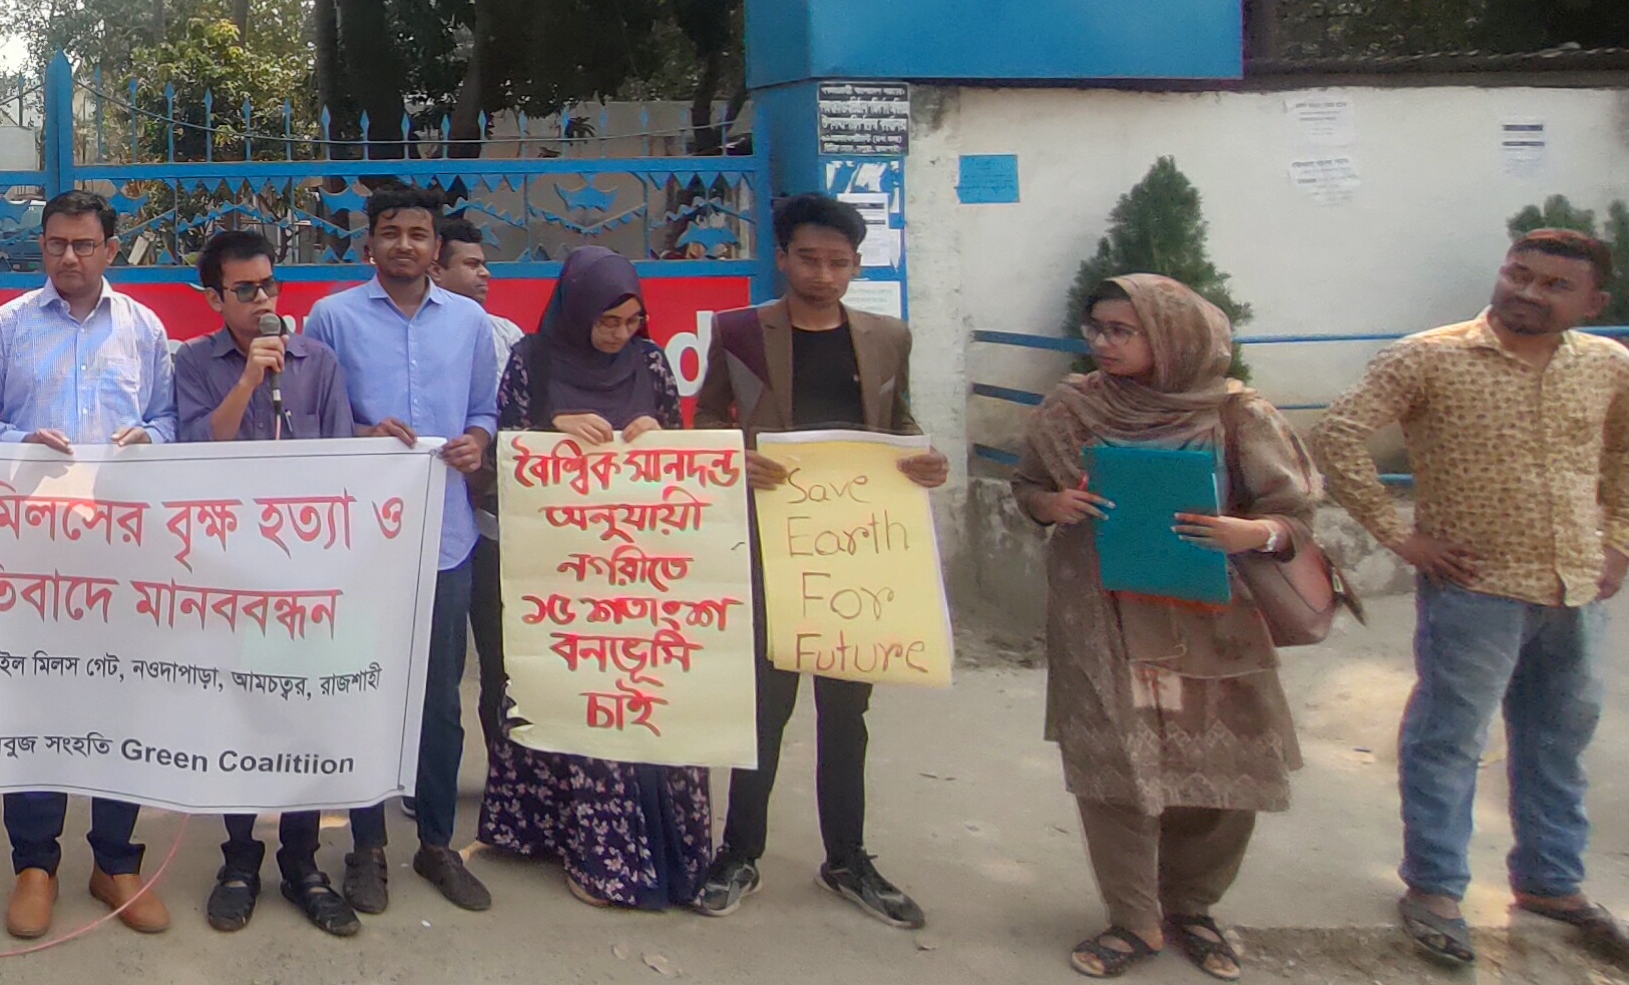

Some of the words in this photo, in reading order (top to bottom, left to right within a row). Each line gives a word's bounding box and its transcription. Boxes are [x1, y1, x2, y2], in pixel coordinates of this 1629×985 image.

[512, 436, 619, 494] বৈশ্বিক
[786, 467, 871, 504] Save
[161, 498, 242, 573] বৃক্ষ
[253, 488, 357, 559] হত্যা
[372, 497, 404, 540] ও
[539, 486, 712, 542] অনুযায়ী
[787, 509, 909, 557] Earth
[557, 546, 694, 591] নগরীতে
[131, 578, 344, 641] মানববন্ধন
[522, 594, 574, 625] ১৫
[580, 595, 742, 632] শতাংশ
[801, 571, 895, 620] For
[32, 650, 77, 677] মিলস
[86, 652, 124, 682] গেট,
[132, 660, 224, 691] নওদাপাড়া,
[232, 670, 312, 700] আমচত্বর,
[320, 662, 382, 697] রাজশাহী
[550, 630, 704, 686] বনভূমি
[796, 630, 929, 673] Future
[580, 679, 668, 737] চাই
[44, 731, 111, 756] সংহতি
[120, 739, 208, 772] Green
[218, 749, 354, 775] Coalitiion
